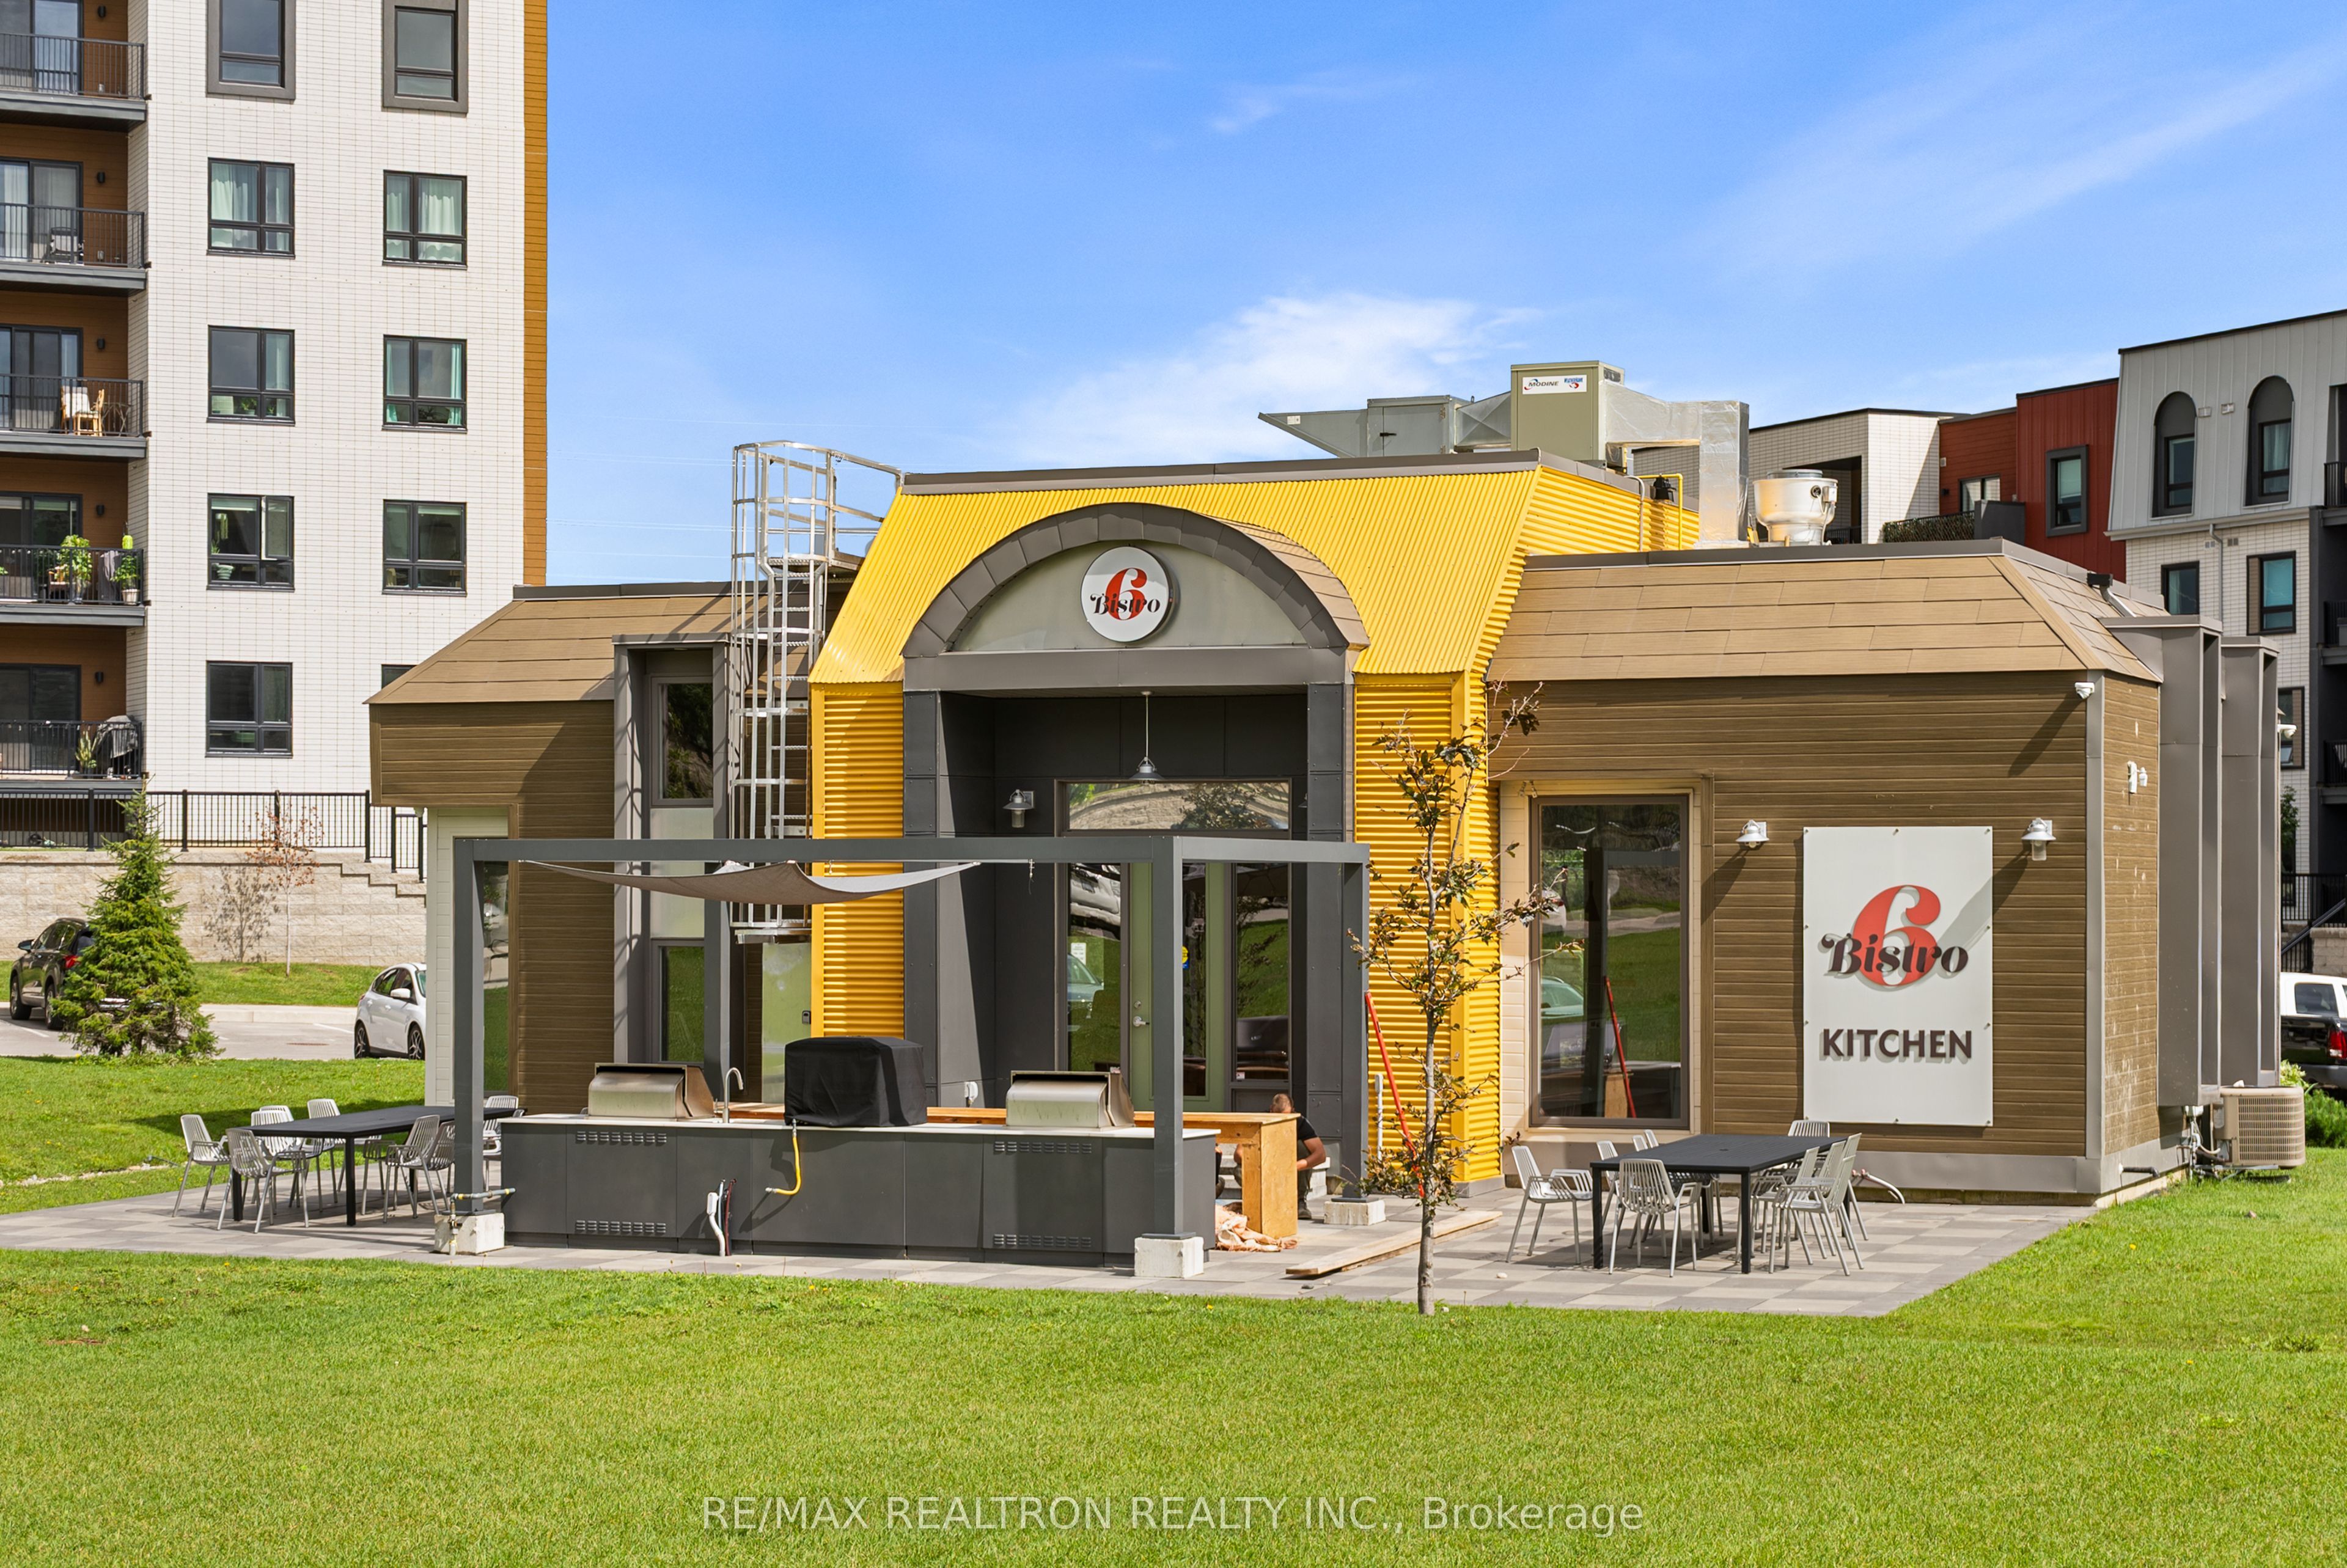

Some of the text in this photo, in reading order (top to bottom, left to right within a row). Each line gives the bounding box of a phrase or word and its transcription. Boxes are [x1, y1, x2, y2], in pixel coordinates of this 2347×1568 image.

[1090, 593, 1161, 615] Bistro
[1105, 567, 1147, 621] 6
[1821, 932, 1969, 974] Bistro
[1853, 884, 1941, 986] 6
[1823, 1028, 1972, 1059] KITCHEN
